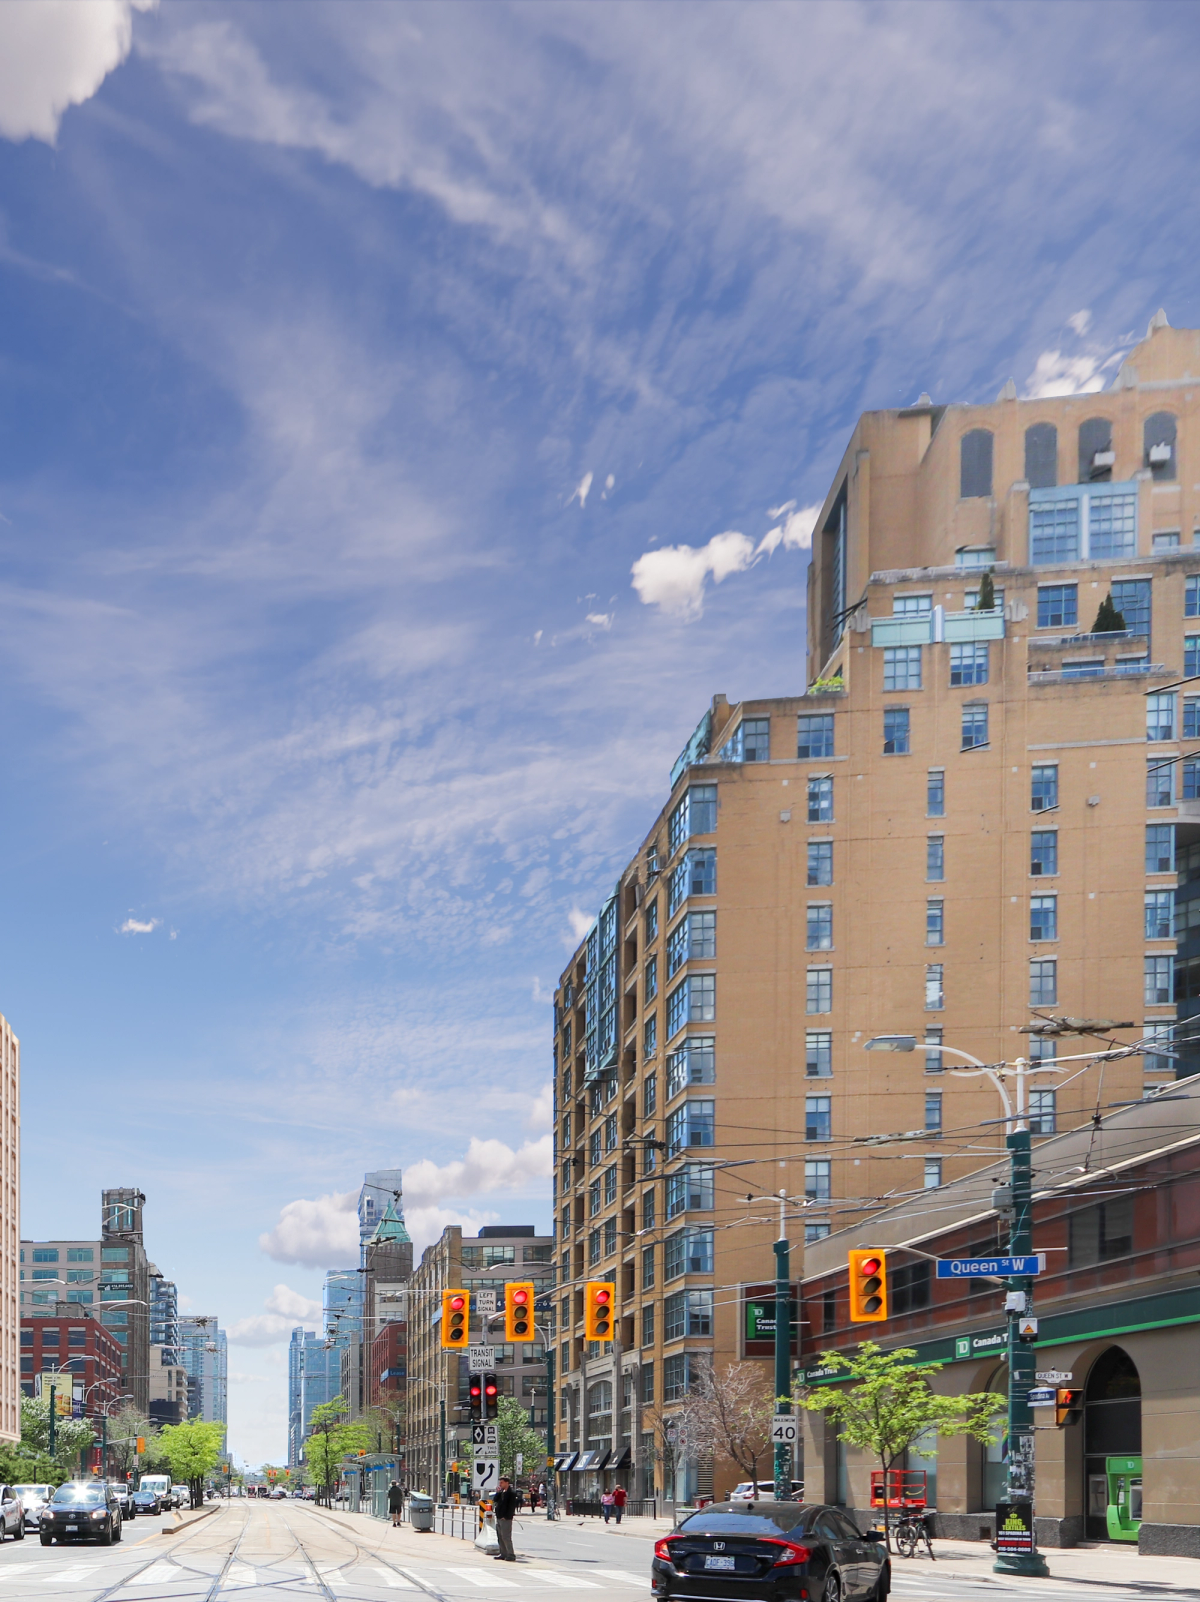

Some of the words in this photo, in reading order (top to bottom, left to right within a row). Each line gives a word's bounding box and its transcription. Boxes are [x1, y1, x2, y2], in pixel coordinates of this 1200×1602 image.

[950, 1261, 998, 1274] Queen
[1001, 1259, 1010, 1267] St
[1012, 1258, 1025, 1271] W
[752, 1308, 763, 1316] TD
[957, 1340, 968, 1354] TD
[973, 1335, 1001, 1347] Canada
[470, 1348, 494, 1357] TRANSIT
[472, 1359, 493, 1367] SIGNAL
[807, 1369, 824, 1378] Canada
[1029, 1392, 1046, 1401] Spadina
[773, 1426, 796, 1440] 40
